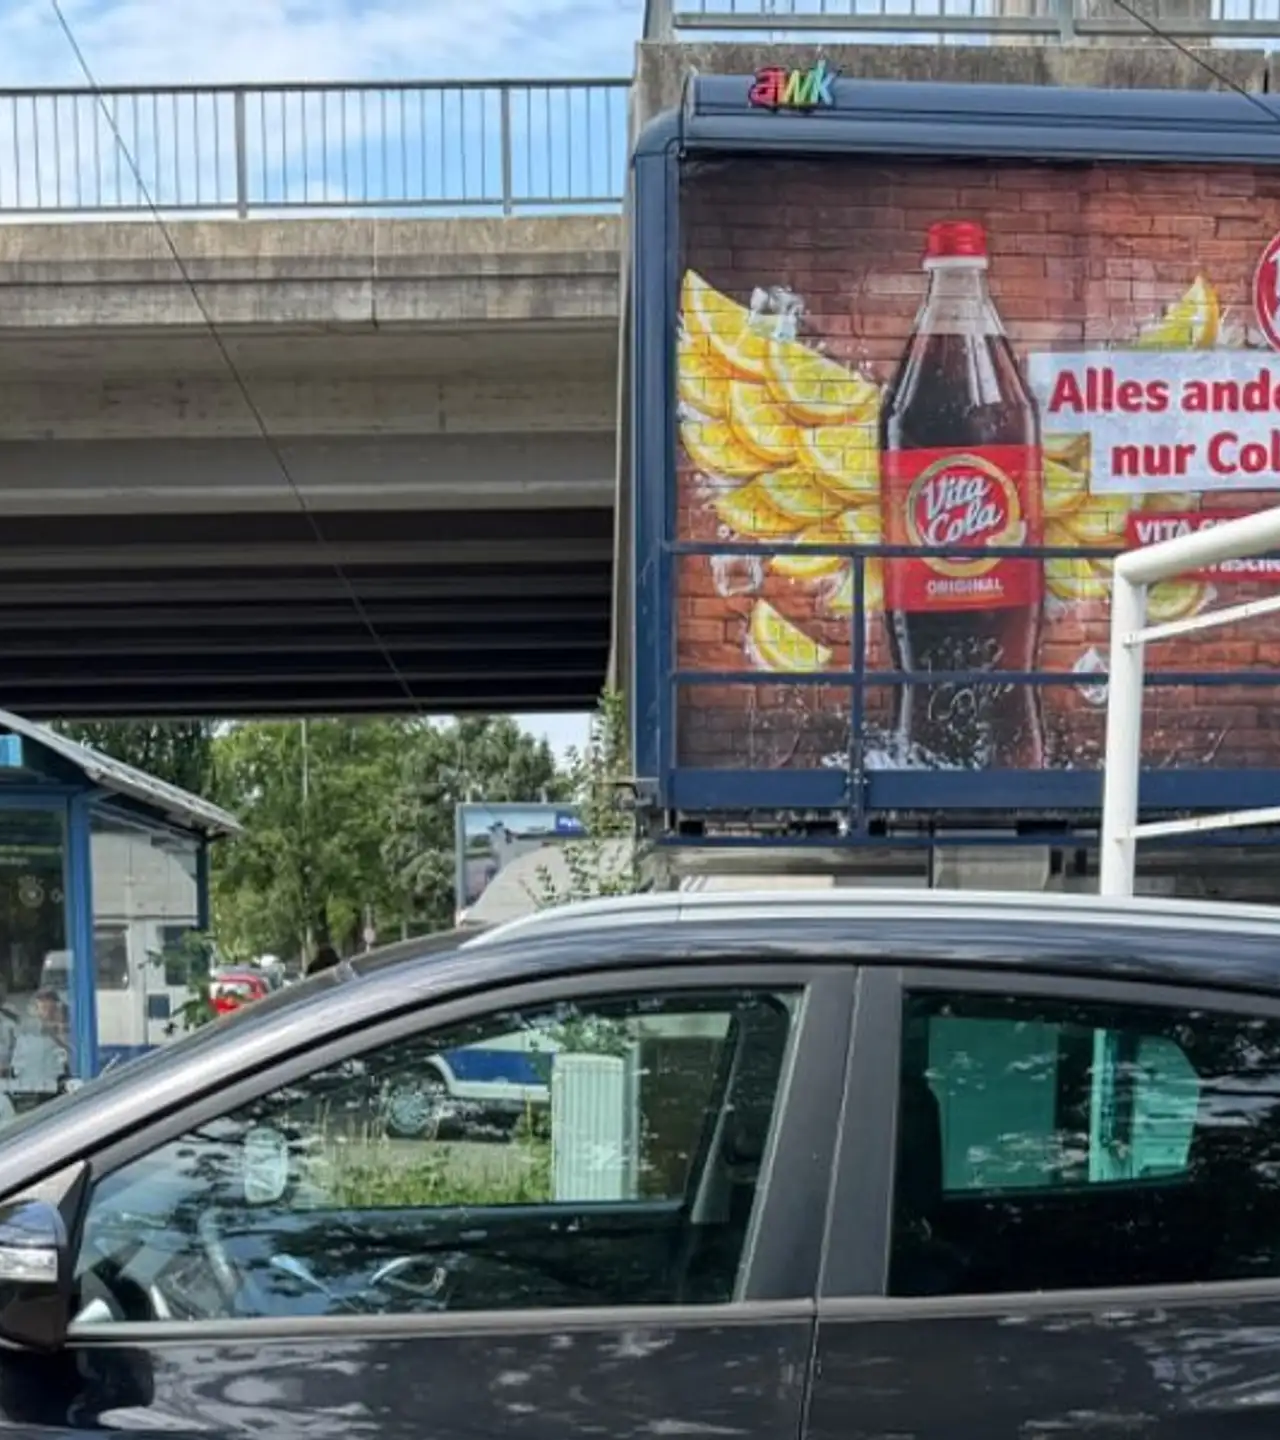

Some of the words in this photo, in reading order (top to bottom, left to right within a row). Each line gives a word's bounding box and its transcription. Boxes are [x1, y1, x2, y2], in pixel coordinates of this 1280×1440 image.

[749, 59, 837, 107] awk
[1048, 366, 1169, 414] Alles
[1111, 440, 1197, 477] nur
[923, 474, 992, 520] Vita
[927, 502, 1003, 548] Cola
[1133, 518, 1192, 545] VITA
